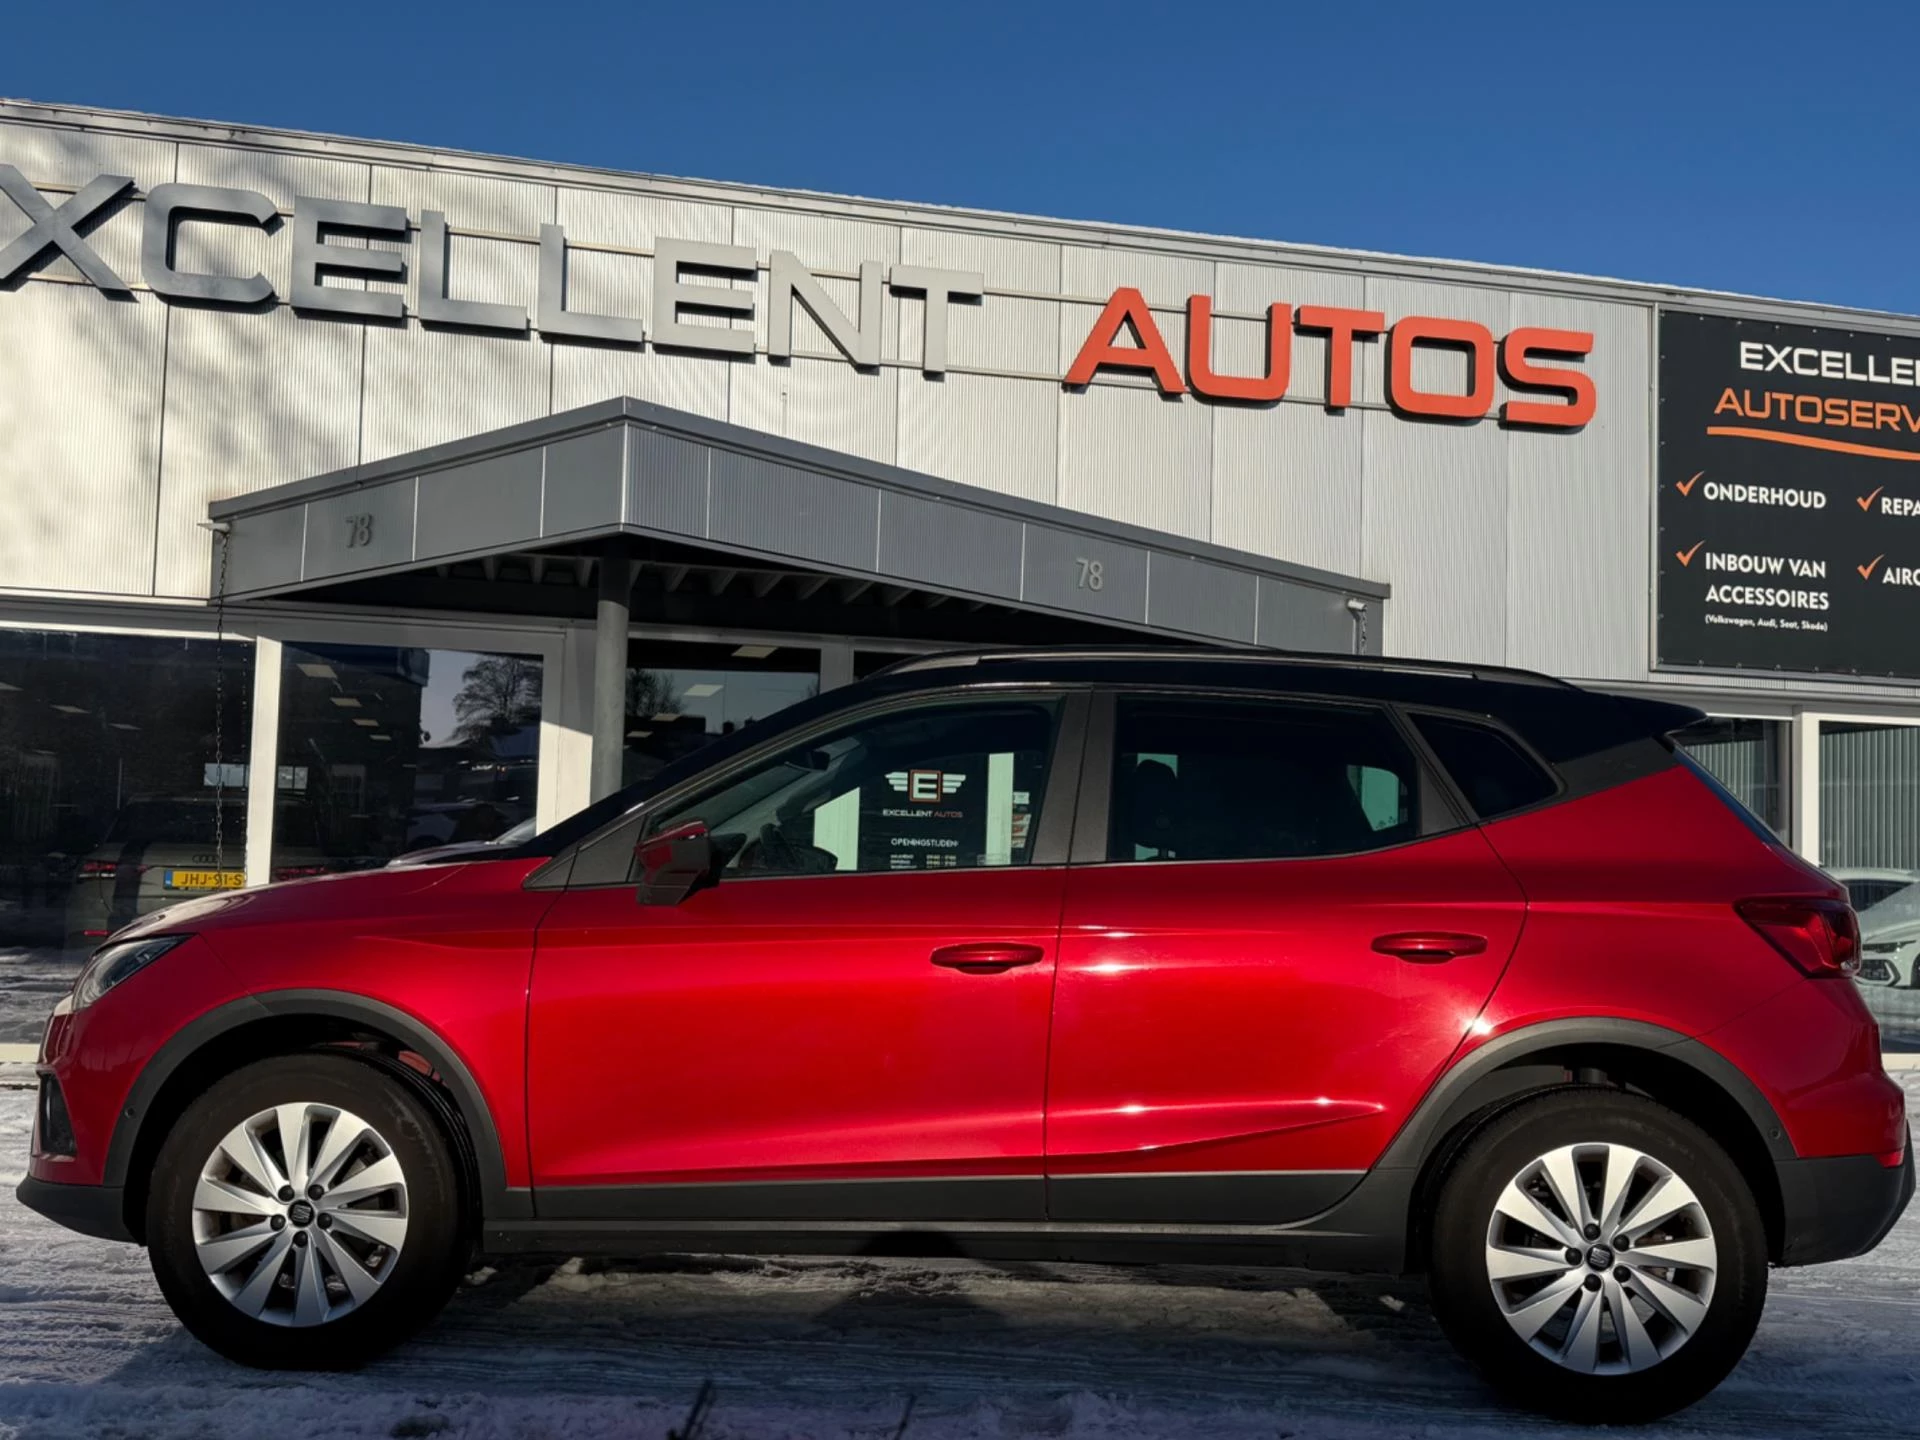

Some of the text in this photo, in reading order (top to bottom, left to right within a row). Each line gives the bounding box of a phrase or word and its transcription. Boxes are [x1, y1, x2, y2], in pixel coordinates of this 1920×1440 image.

[0, 164, 1597, 427] XCELLENT AUTOS
[1740, 341, 1920, 387] EXCELLE
[1703, 482, 1826, 509] ONDERHOUD
[345, 511, 373, 547] 78
[1075, 557, 1104, 591] 78
[1705, 552, 1826, 579] INBOUW VAN
[1705, 584, 1829, 610] ACCESSOIRES
[883, 809, 932, 817] EXCELLENT
